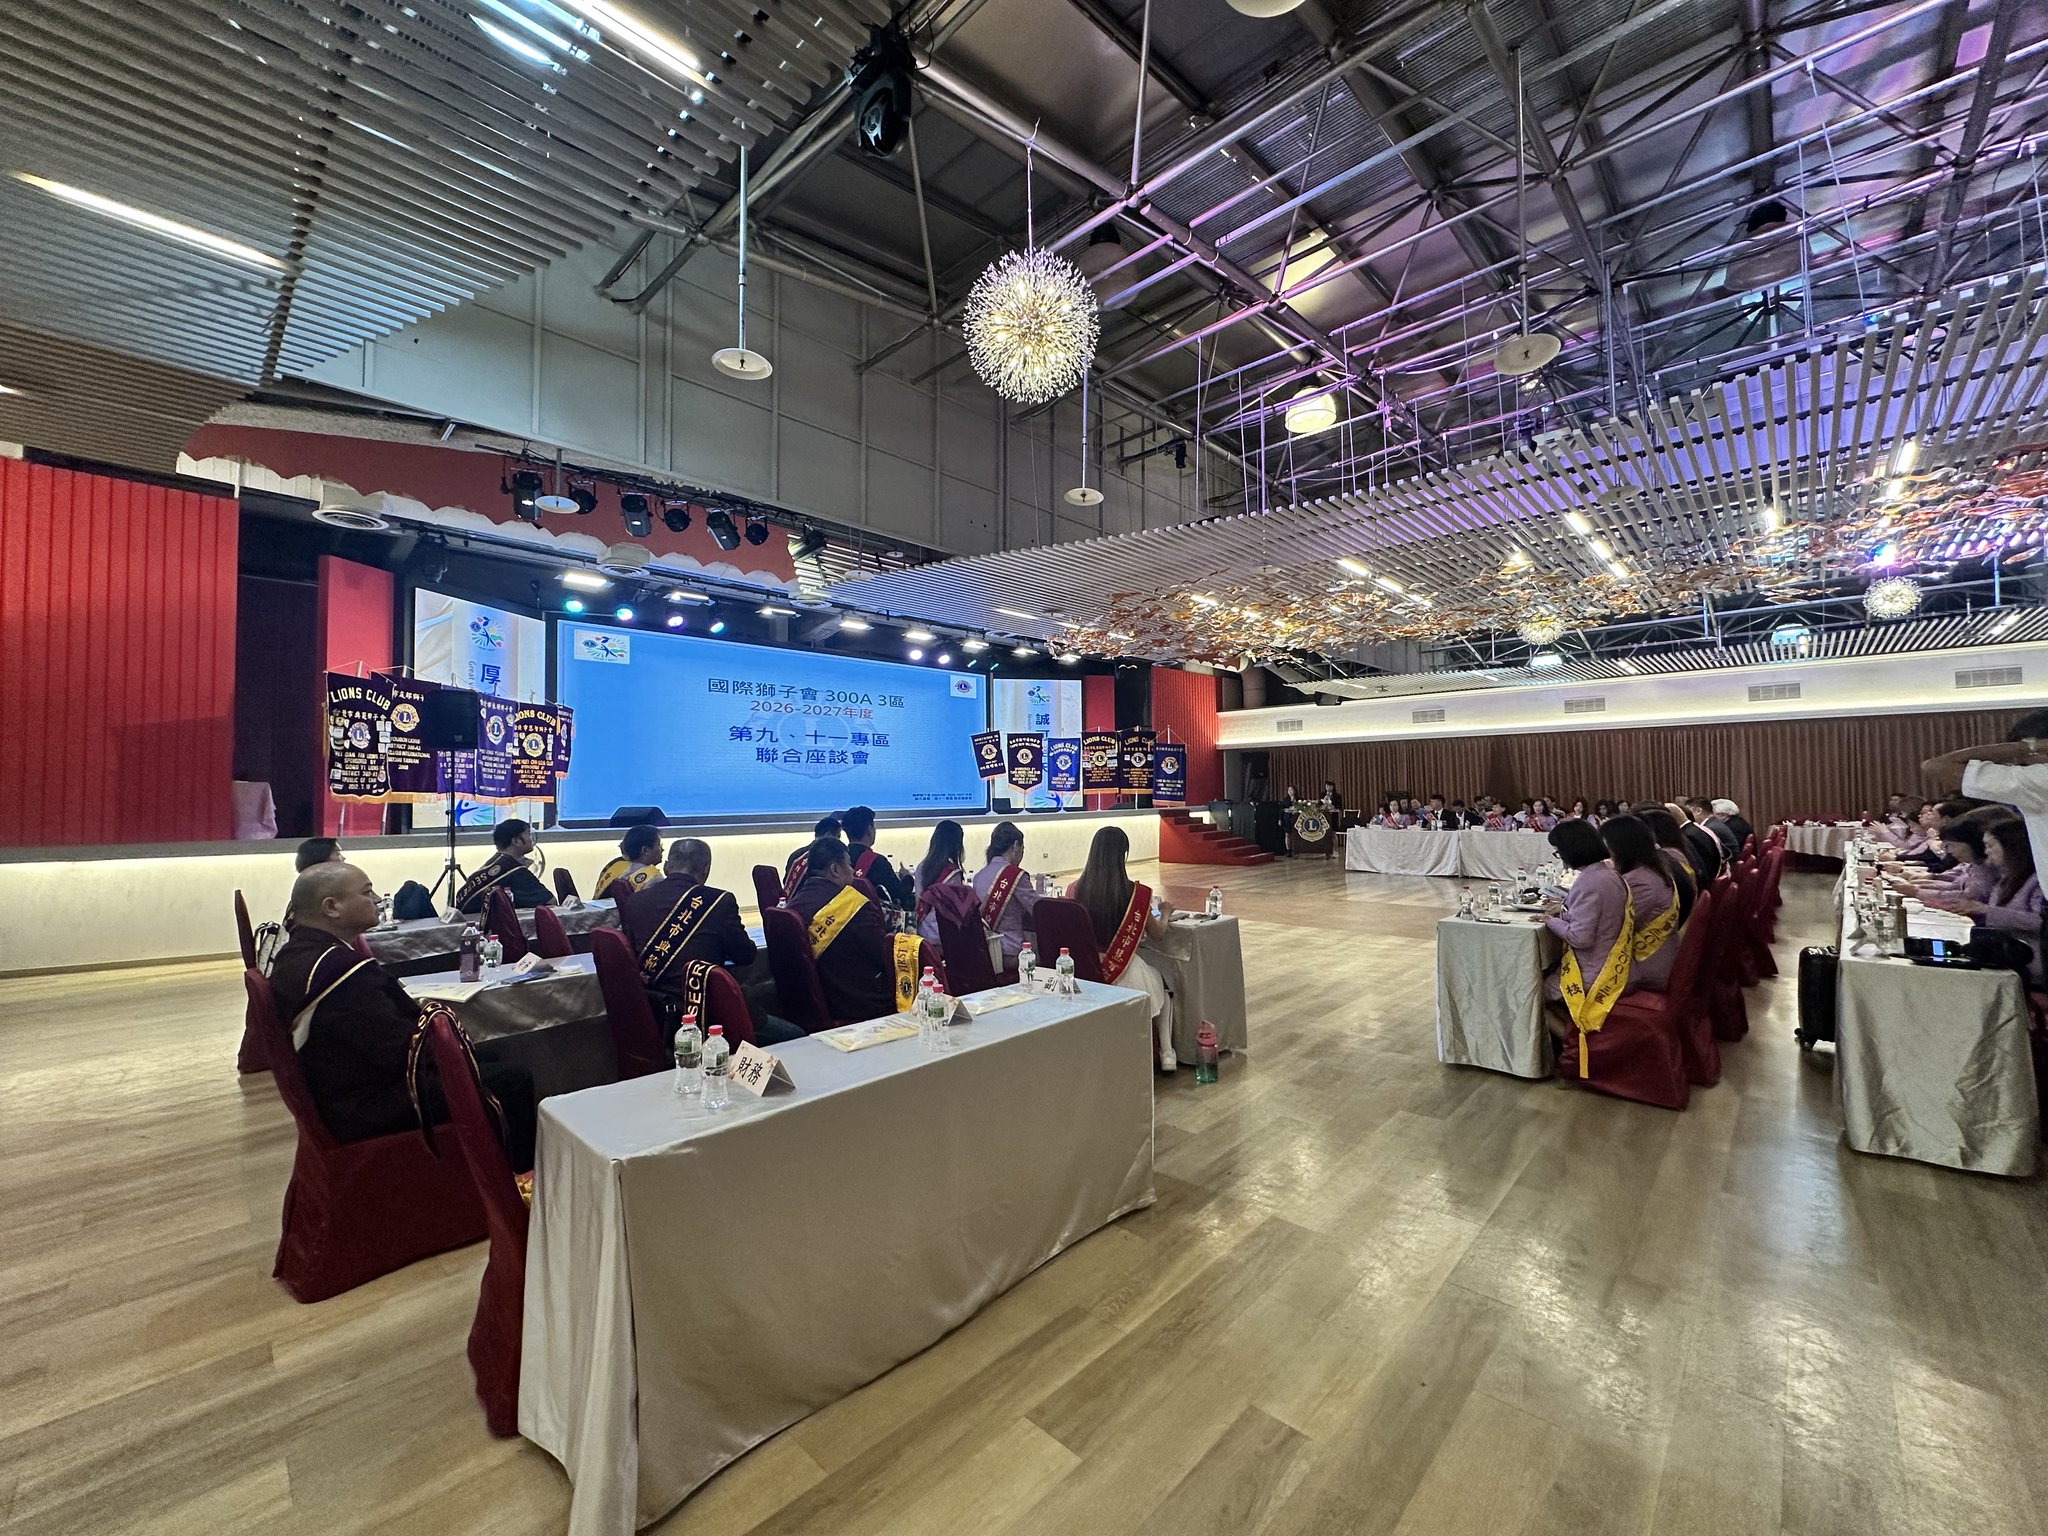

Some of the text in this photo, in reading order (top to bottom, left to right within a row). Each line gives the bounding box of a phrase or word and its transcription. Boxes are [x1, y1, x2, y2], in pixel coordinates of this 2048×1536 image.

[481, 663, 502, 685] 厚
[330, 687, 391, 711] LIONS CLUB
[708, 678, 905, 709] 國際獅子會 300A 3區
[536, 711, 557, 727] CLUB
[750, 700, 874, 720] 2026-2027年度
[729, 725, 890, 748] 第九、十一專區
[1083, 736, 1116, 745] LIONS CLUB
[755, 747, 870, 765] 聯合座談會
[896, 948, 910, 974] FIRST
[735, 1056, 763, 1086] 財務
